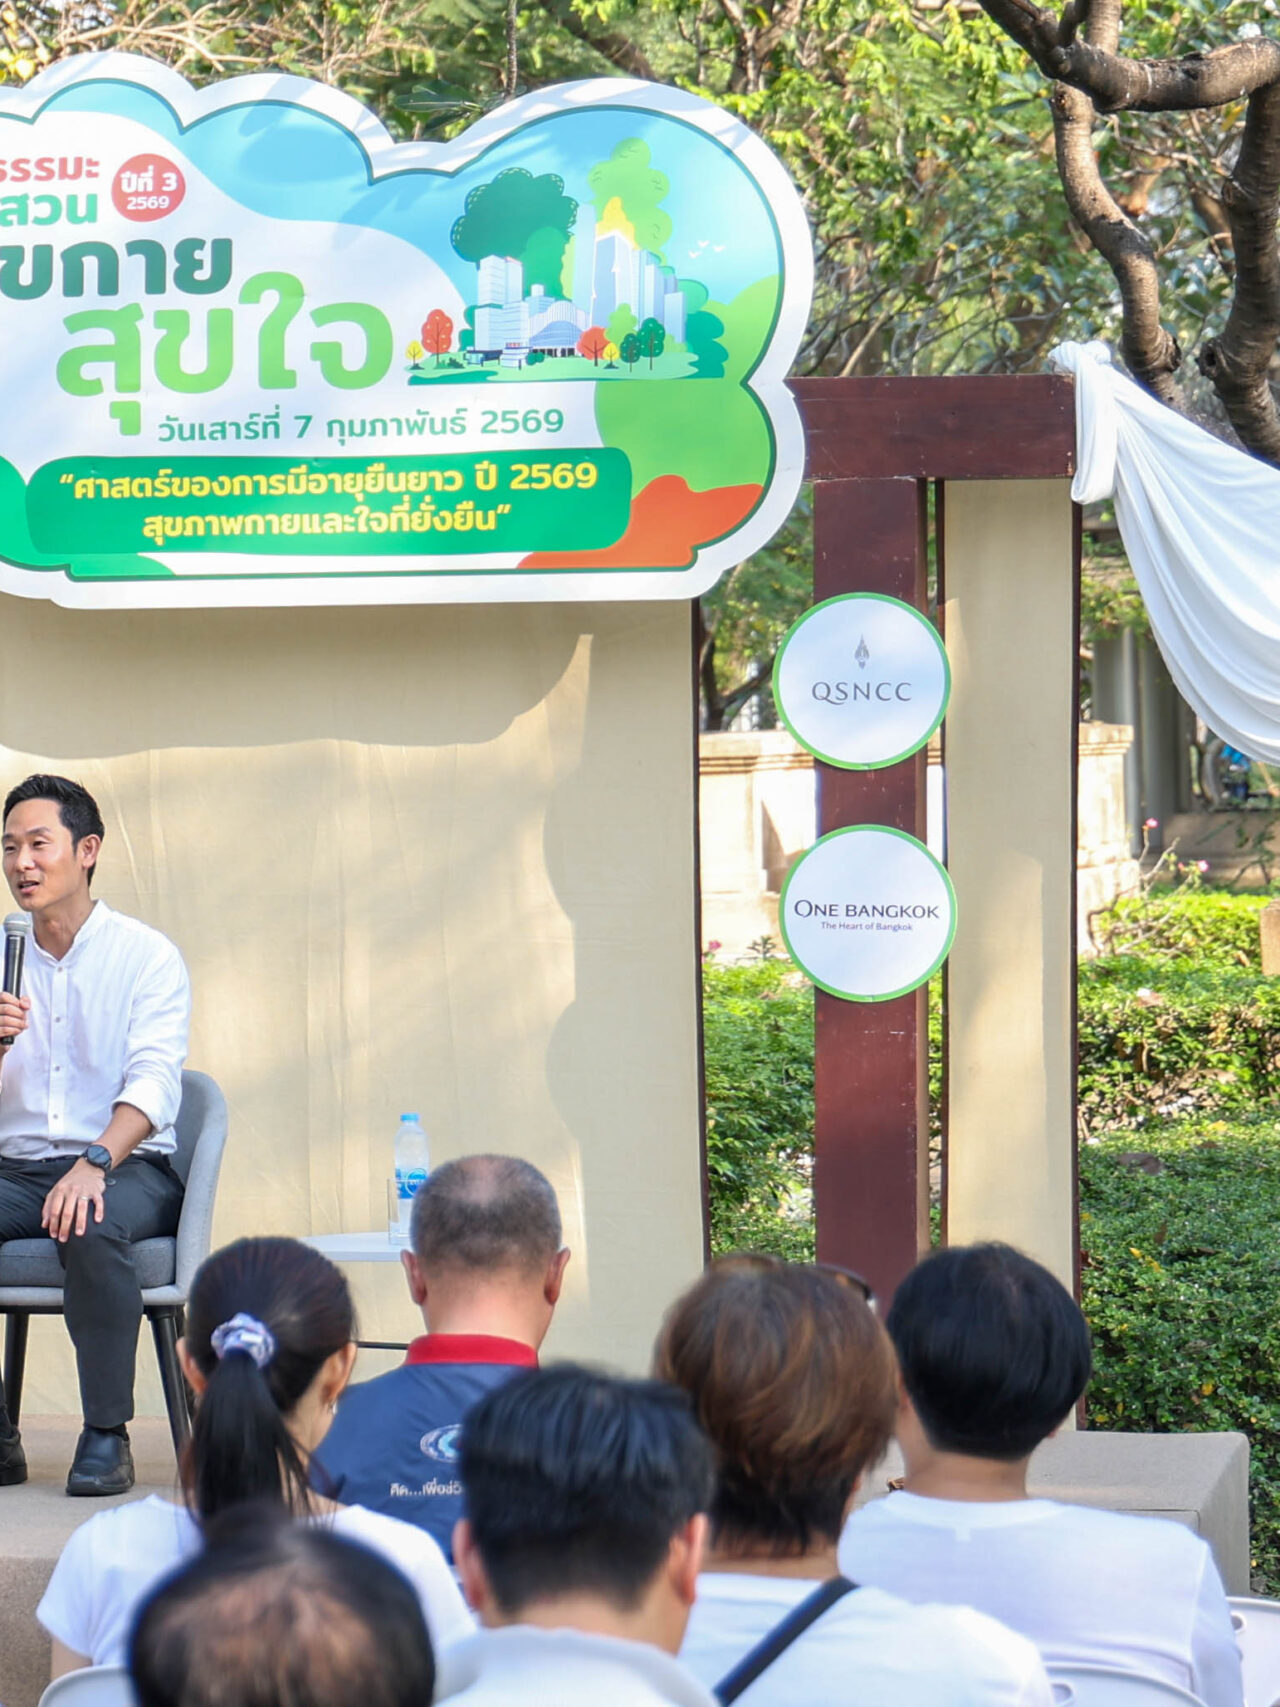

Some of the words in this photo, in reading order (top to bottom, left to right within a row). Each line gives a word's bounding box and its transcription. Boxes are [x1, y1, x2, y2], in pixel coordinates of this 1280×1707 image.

[121, 166, 155, 194] ปีที่
[161, 172, 177, 193] 3
[127, 196, 169, 211] 2569
[56, 271, 393, 436] สุขใจ
[158, 405, 280, 442] วันเสาร์ที่
[294, 415, 313, 439] 7
[326, 408, 468, 446] กุมภาพันธ์
[480, 408, 564, 434] 2569
[474, 461, 497, 491] ปี
[509, 462, 598, 490] 2569
[812, 681, 912, 705] QSNCC
[794, 900, 839, 918] ONE
[845, 904, 940, 919] BANGKOK
[821, 921, 837, 930] The
[839, 922, 863, 931] Heart
[865, 921, 874, 931] of
[876, 923, 913, 932] Bangkok
